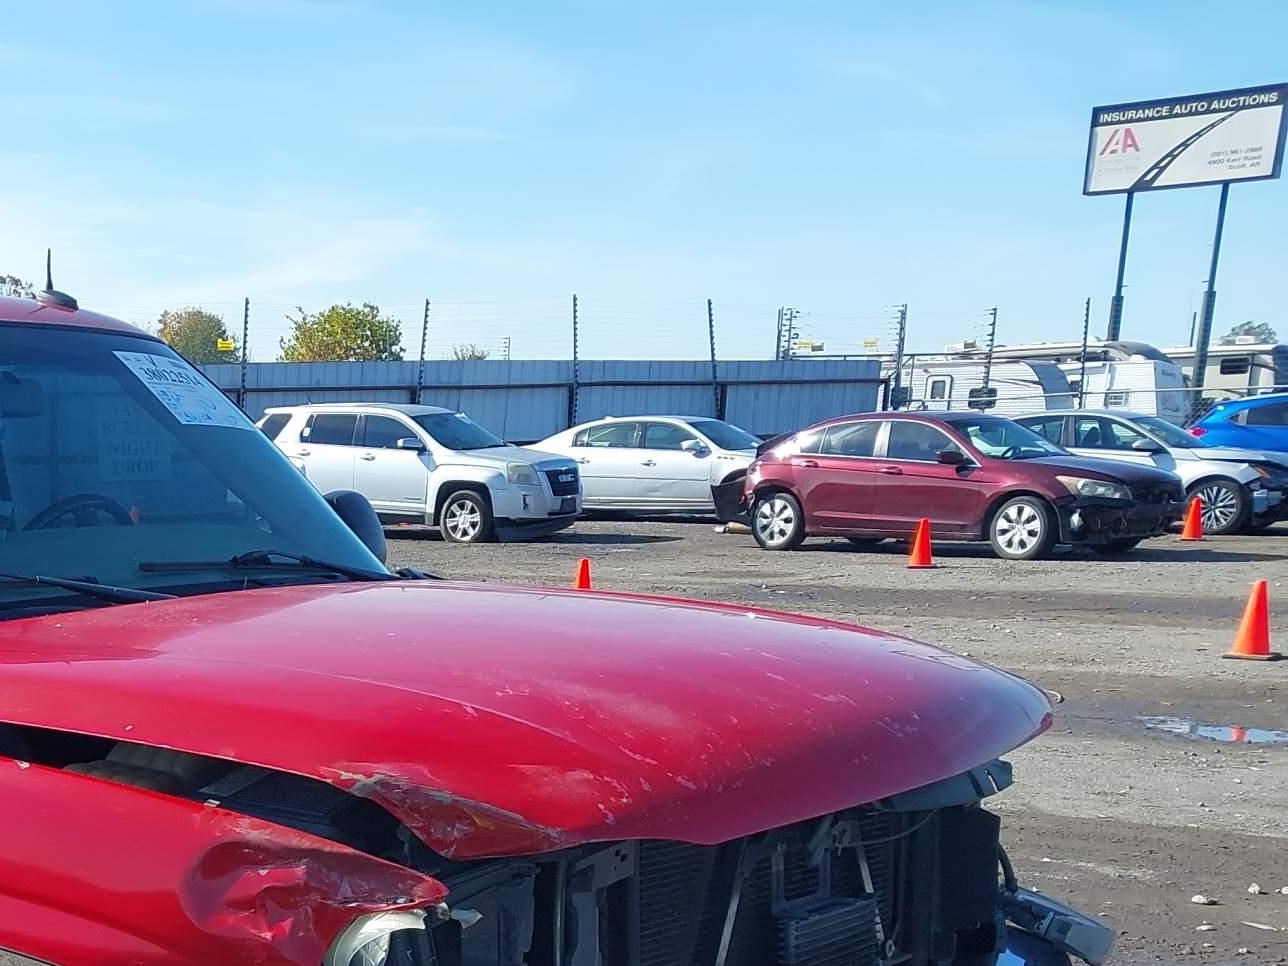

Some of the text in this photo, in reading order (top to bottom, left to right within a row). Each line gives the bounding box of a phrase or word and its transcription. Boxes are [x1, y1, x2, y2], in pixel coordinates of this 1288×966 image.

[1099, 92, 1279, 123] INSURANCE AUTO AUCTIONS
[138, 366, 205, 388] 38022514
